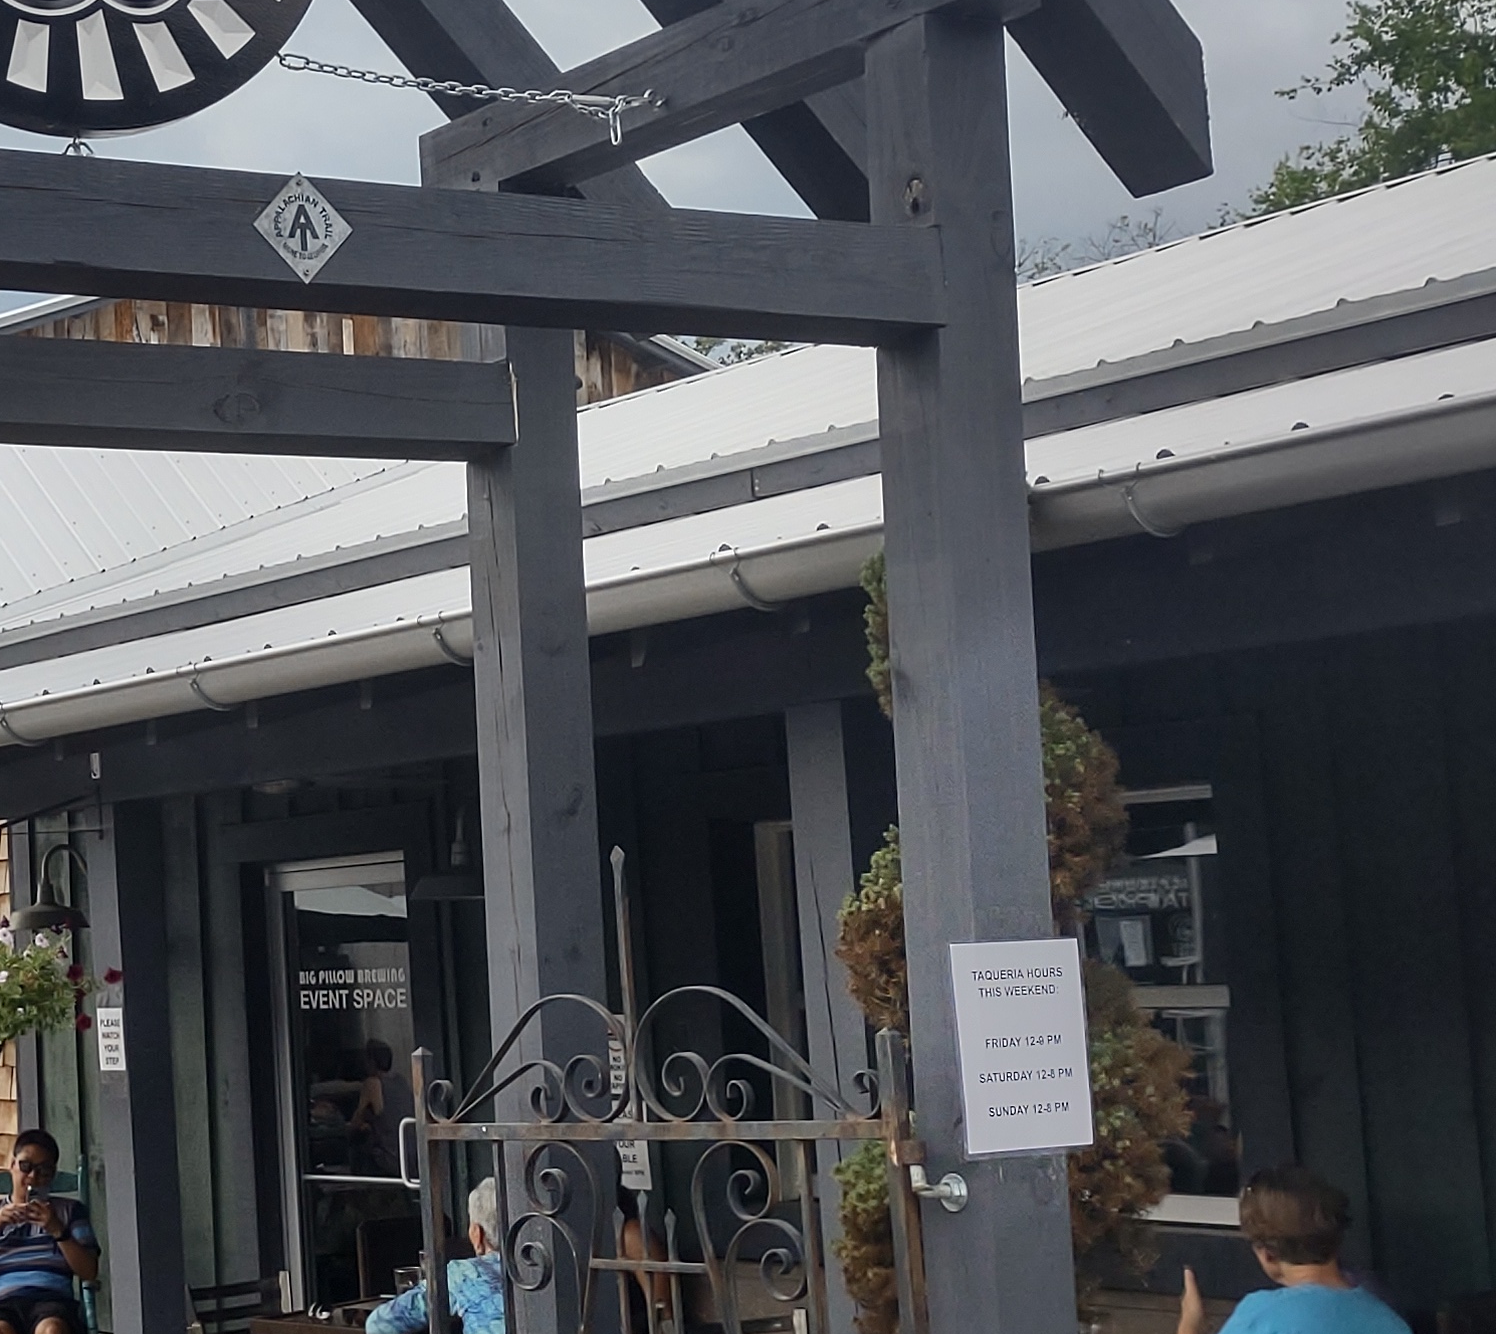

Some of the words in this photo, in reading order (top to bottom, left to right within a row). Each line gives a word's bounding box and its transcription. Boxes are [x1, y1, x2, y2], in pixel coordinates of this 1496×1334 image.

[273, 193, 319, 238] APPALACHIAN
[319, 206, 334, 240] TRAIL
[299, 970, 316, 985] BIG
[319, 969, 355, 985] PILLOW
[357, 967, 405, 984] BREWING
[971, 969, 1024, 982] TAQUERIA
[1027, 967, 1063, 979] HOURS
[300, 989, 349, 1009] EVENT
[353, 988, 407, 1009] SPACE
[979, 987, 1002, 998] THIS
[1005, 984, 1059, 997] WEEKEND:
[100, 1018, 120, 1027] PLEASE
[104, 1044, 119, 1052] YOUR
[985, 1037, 1022, 1049] FRIDAY
[1047, 1034, 1062, 1045] PM
[105, 1057, 119, 1065] STEP
[979, 1070, 1033, 1083] SATURDAY
[1058, 1067, 1073, 1078] PM
[988, 1105, 1029, 1117] SUNDAY
[1055, 1101, 1070, 1112] PM
